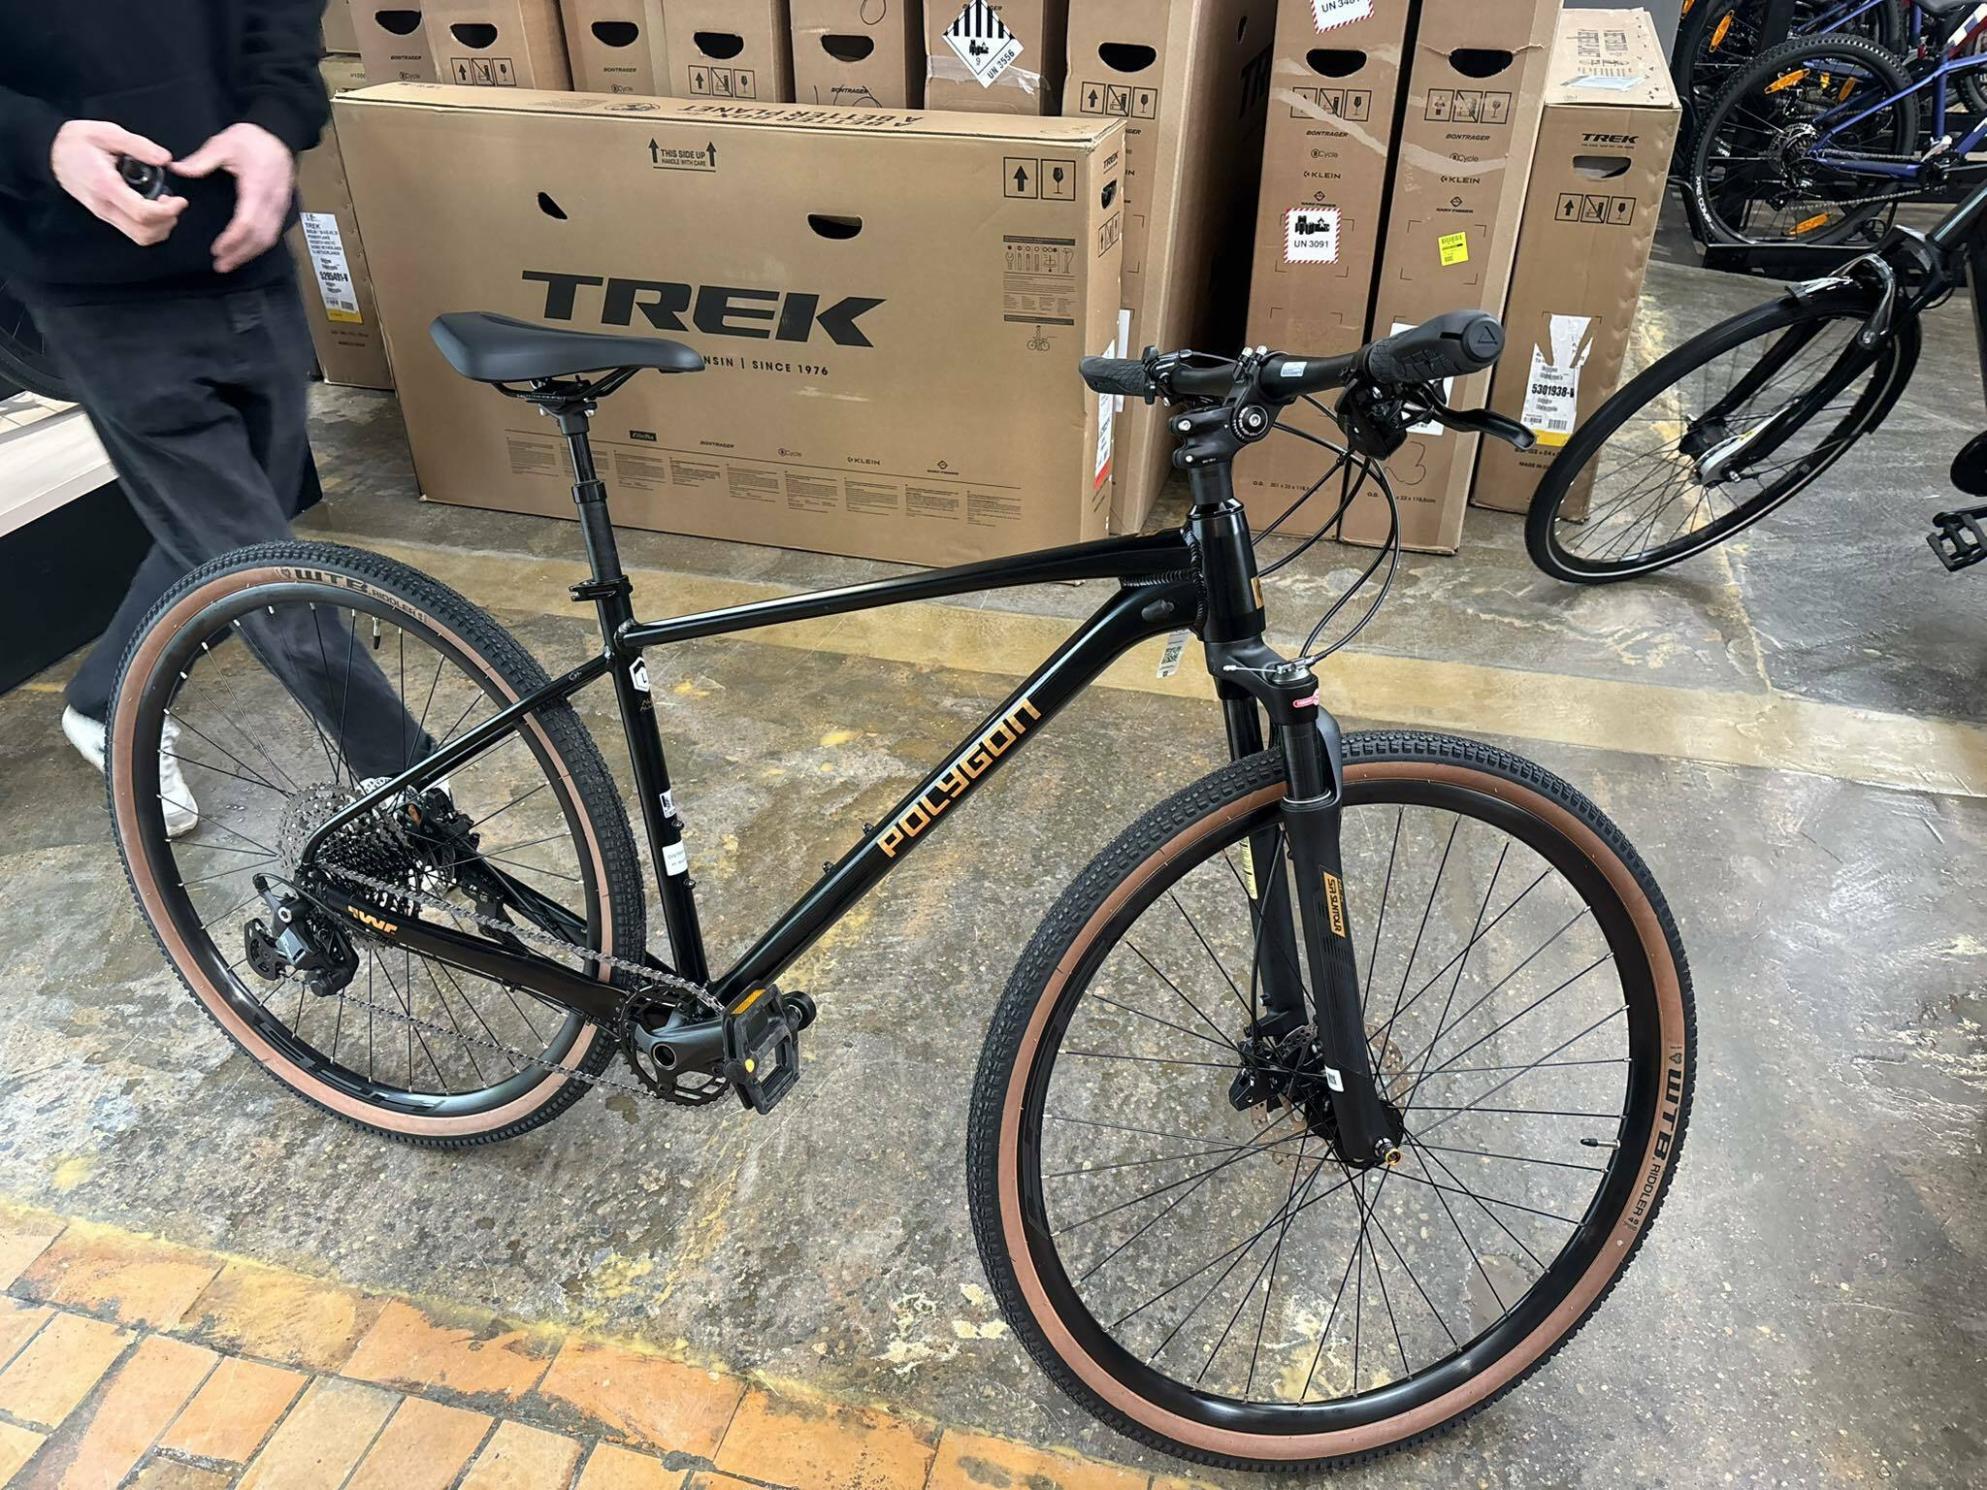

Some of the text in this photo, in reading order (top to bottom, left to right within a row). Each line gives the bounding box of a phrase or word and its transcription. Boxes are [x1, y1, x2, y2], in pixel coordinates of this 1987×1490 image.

[1321, 0, 1361, 13] UN 34
[975, 57, 981, 66] 9
[986, 49, 1015, 79] UN 3556
[677, 104, 783, 116] PLANET
[1306, 130, 1348, 138] BONTRAGER
[1445, 133, 1491, 141] BONTRAGER
[1582, 133, 1640, 144] TREK
[660, 149, 706, 159] THIS SIDE UP
[1103, 151, 1119, 169] TREK
[1308, 240, 1329, 248] 3091
[521, 270, 888, 348] TREK
[703, 355, 829, 376] NSIN SINCE 1976
[294, 569, 369, 593] WTB
[876, 697, 1042, 858] POLYGON
[1327, 878, 1337, 894] SR
[1329, 894, 1342, 932] SUNTOUR
[1633, 1068, 1682, 1216] WTB RIDDLER
